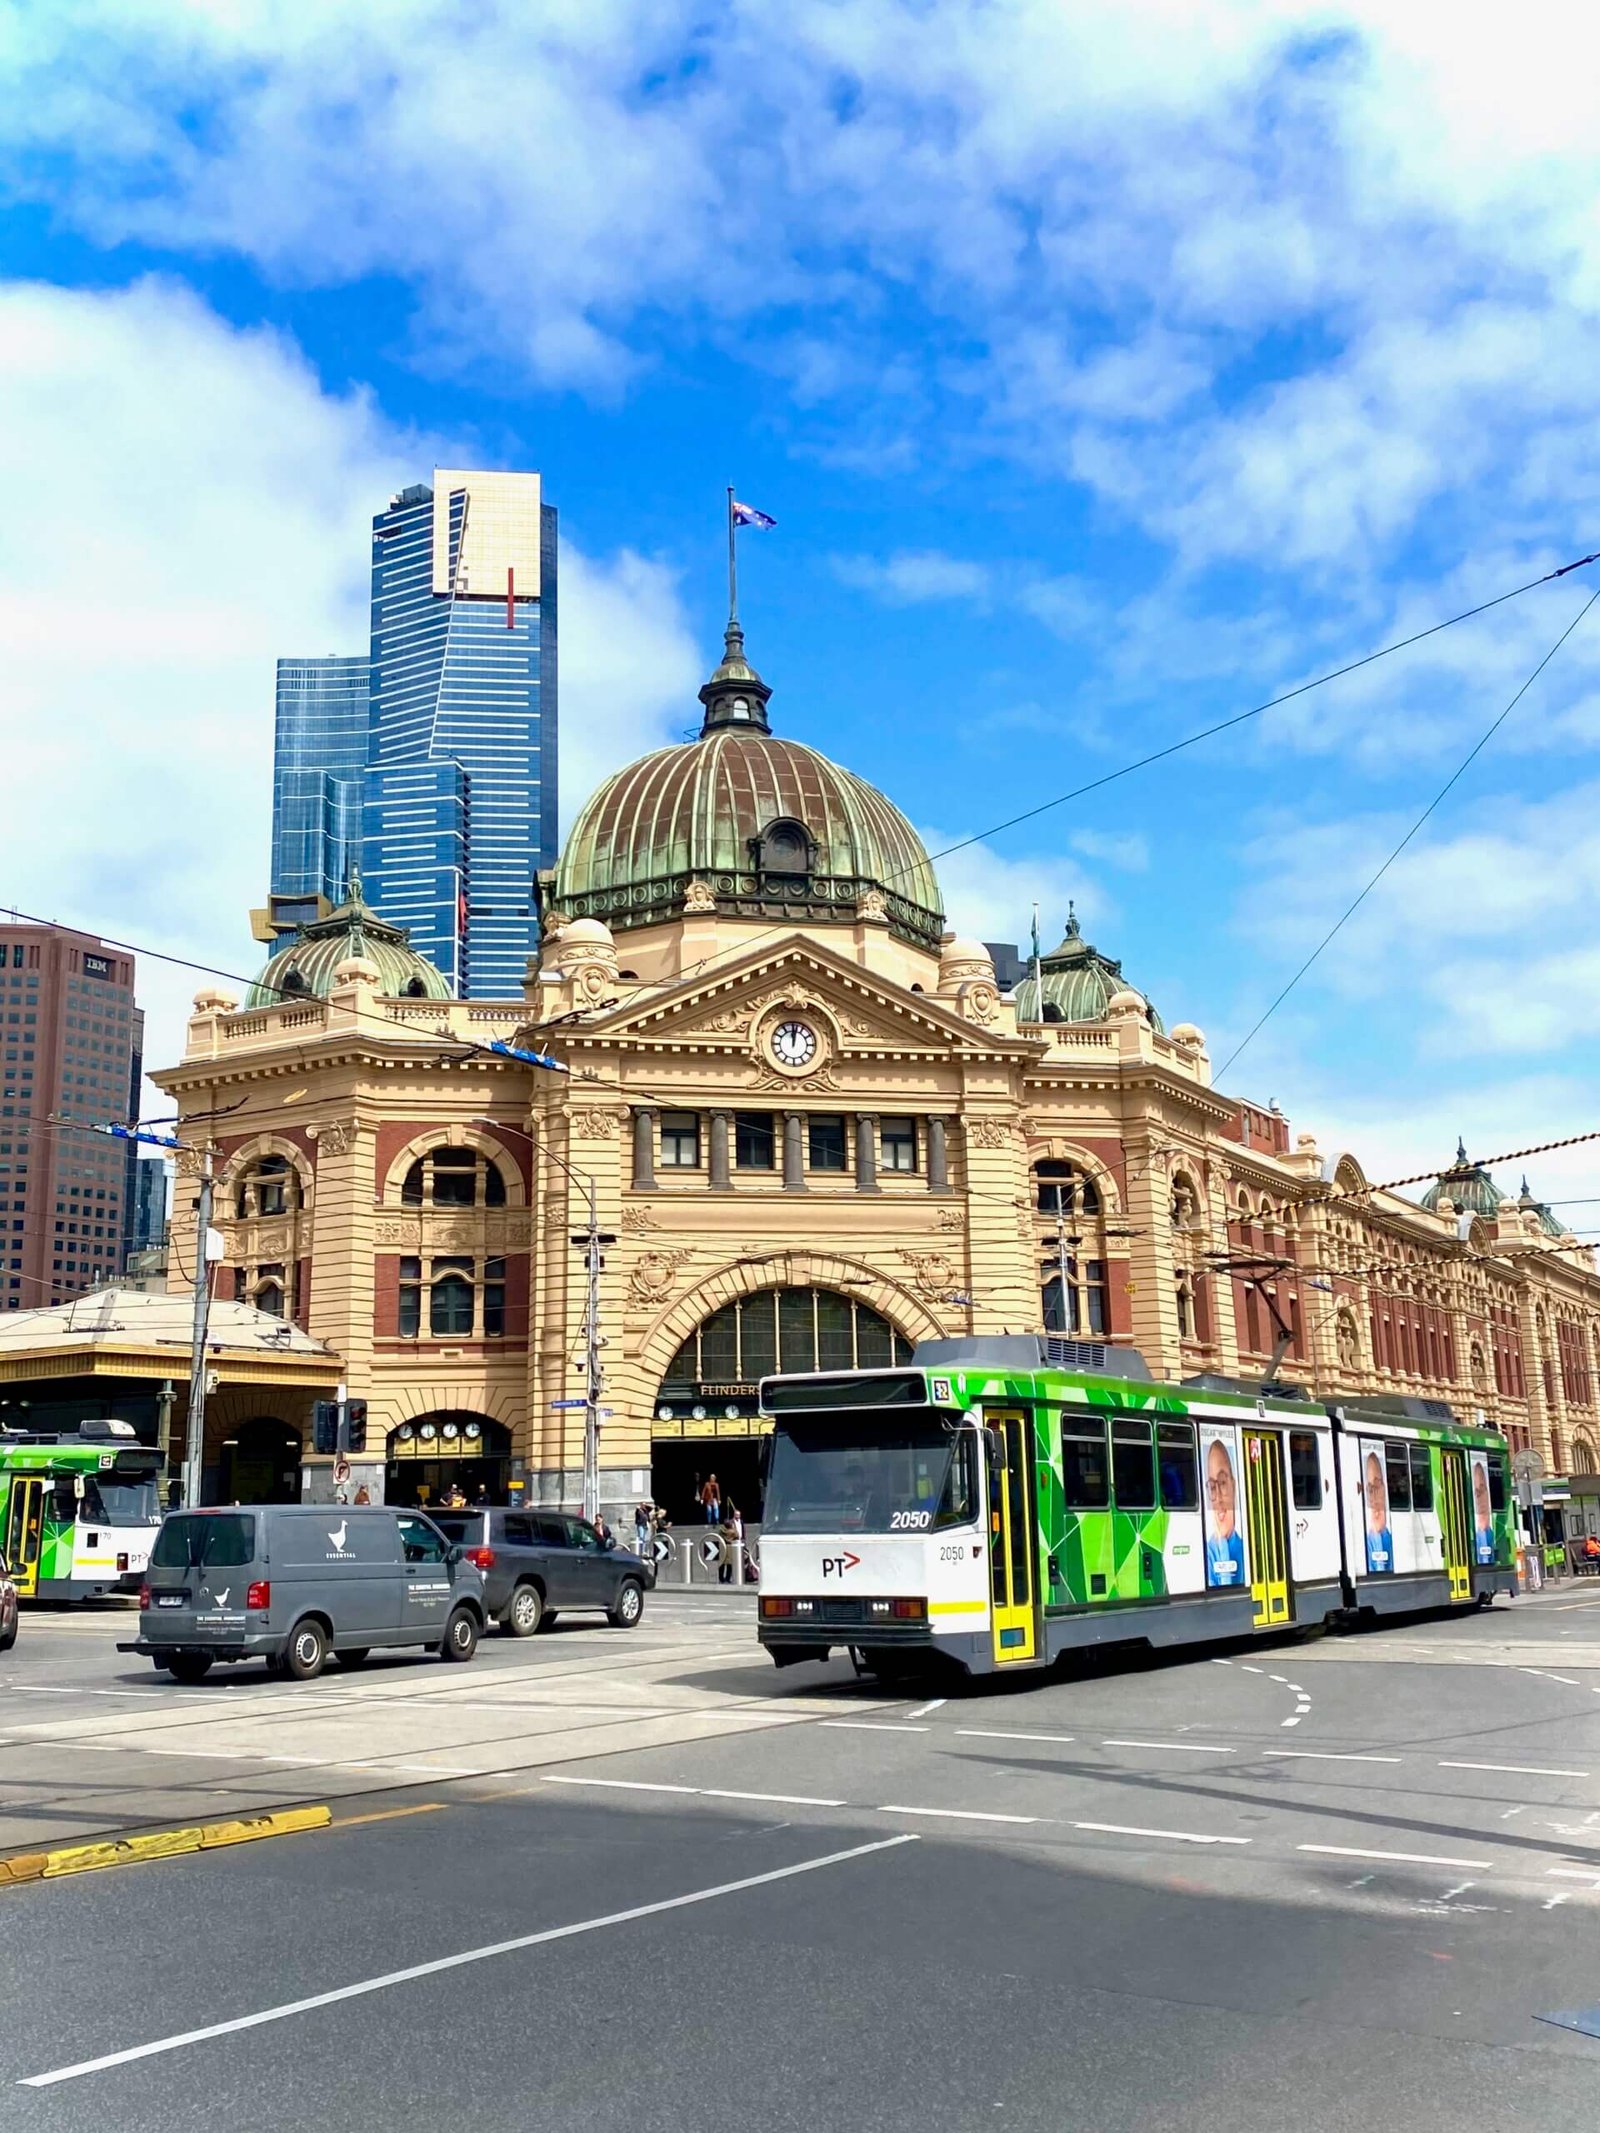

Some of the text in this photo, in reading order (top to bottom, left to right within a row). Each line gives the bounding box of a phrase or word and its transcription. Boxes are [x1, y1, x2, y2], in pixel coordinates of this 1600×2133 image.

[87, 957, 107, 972] IBM
[890, 1511, 931, 1528] 2050
[940, 1546, 964, 1560] 2050
